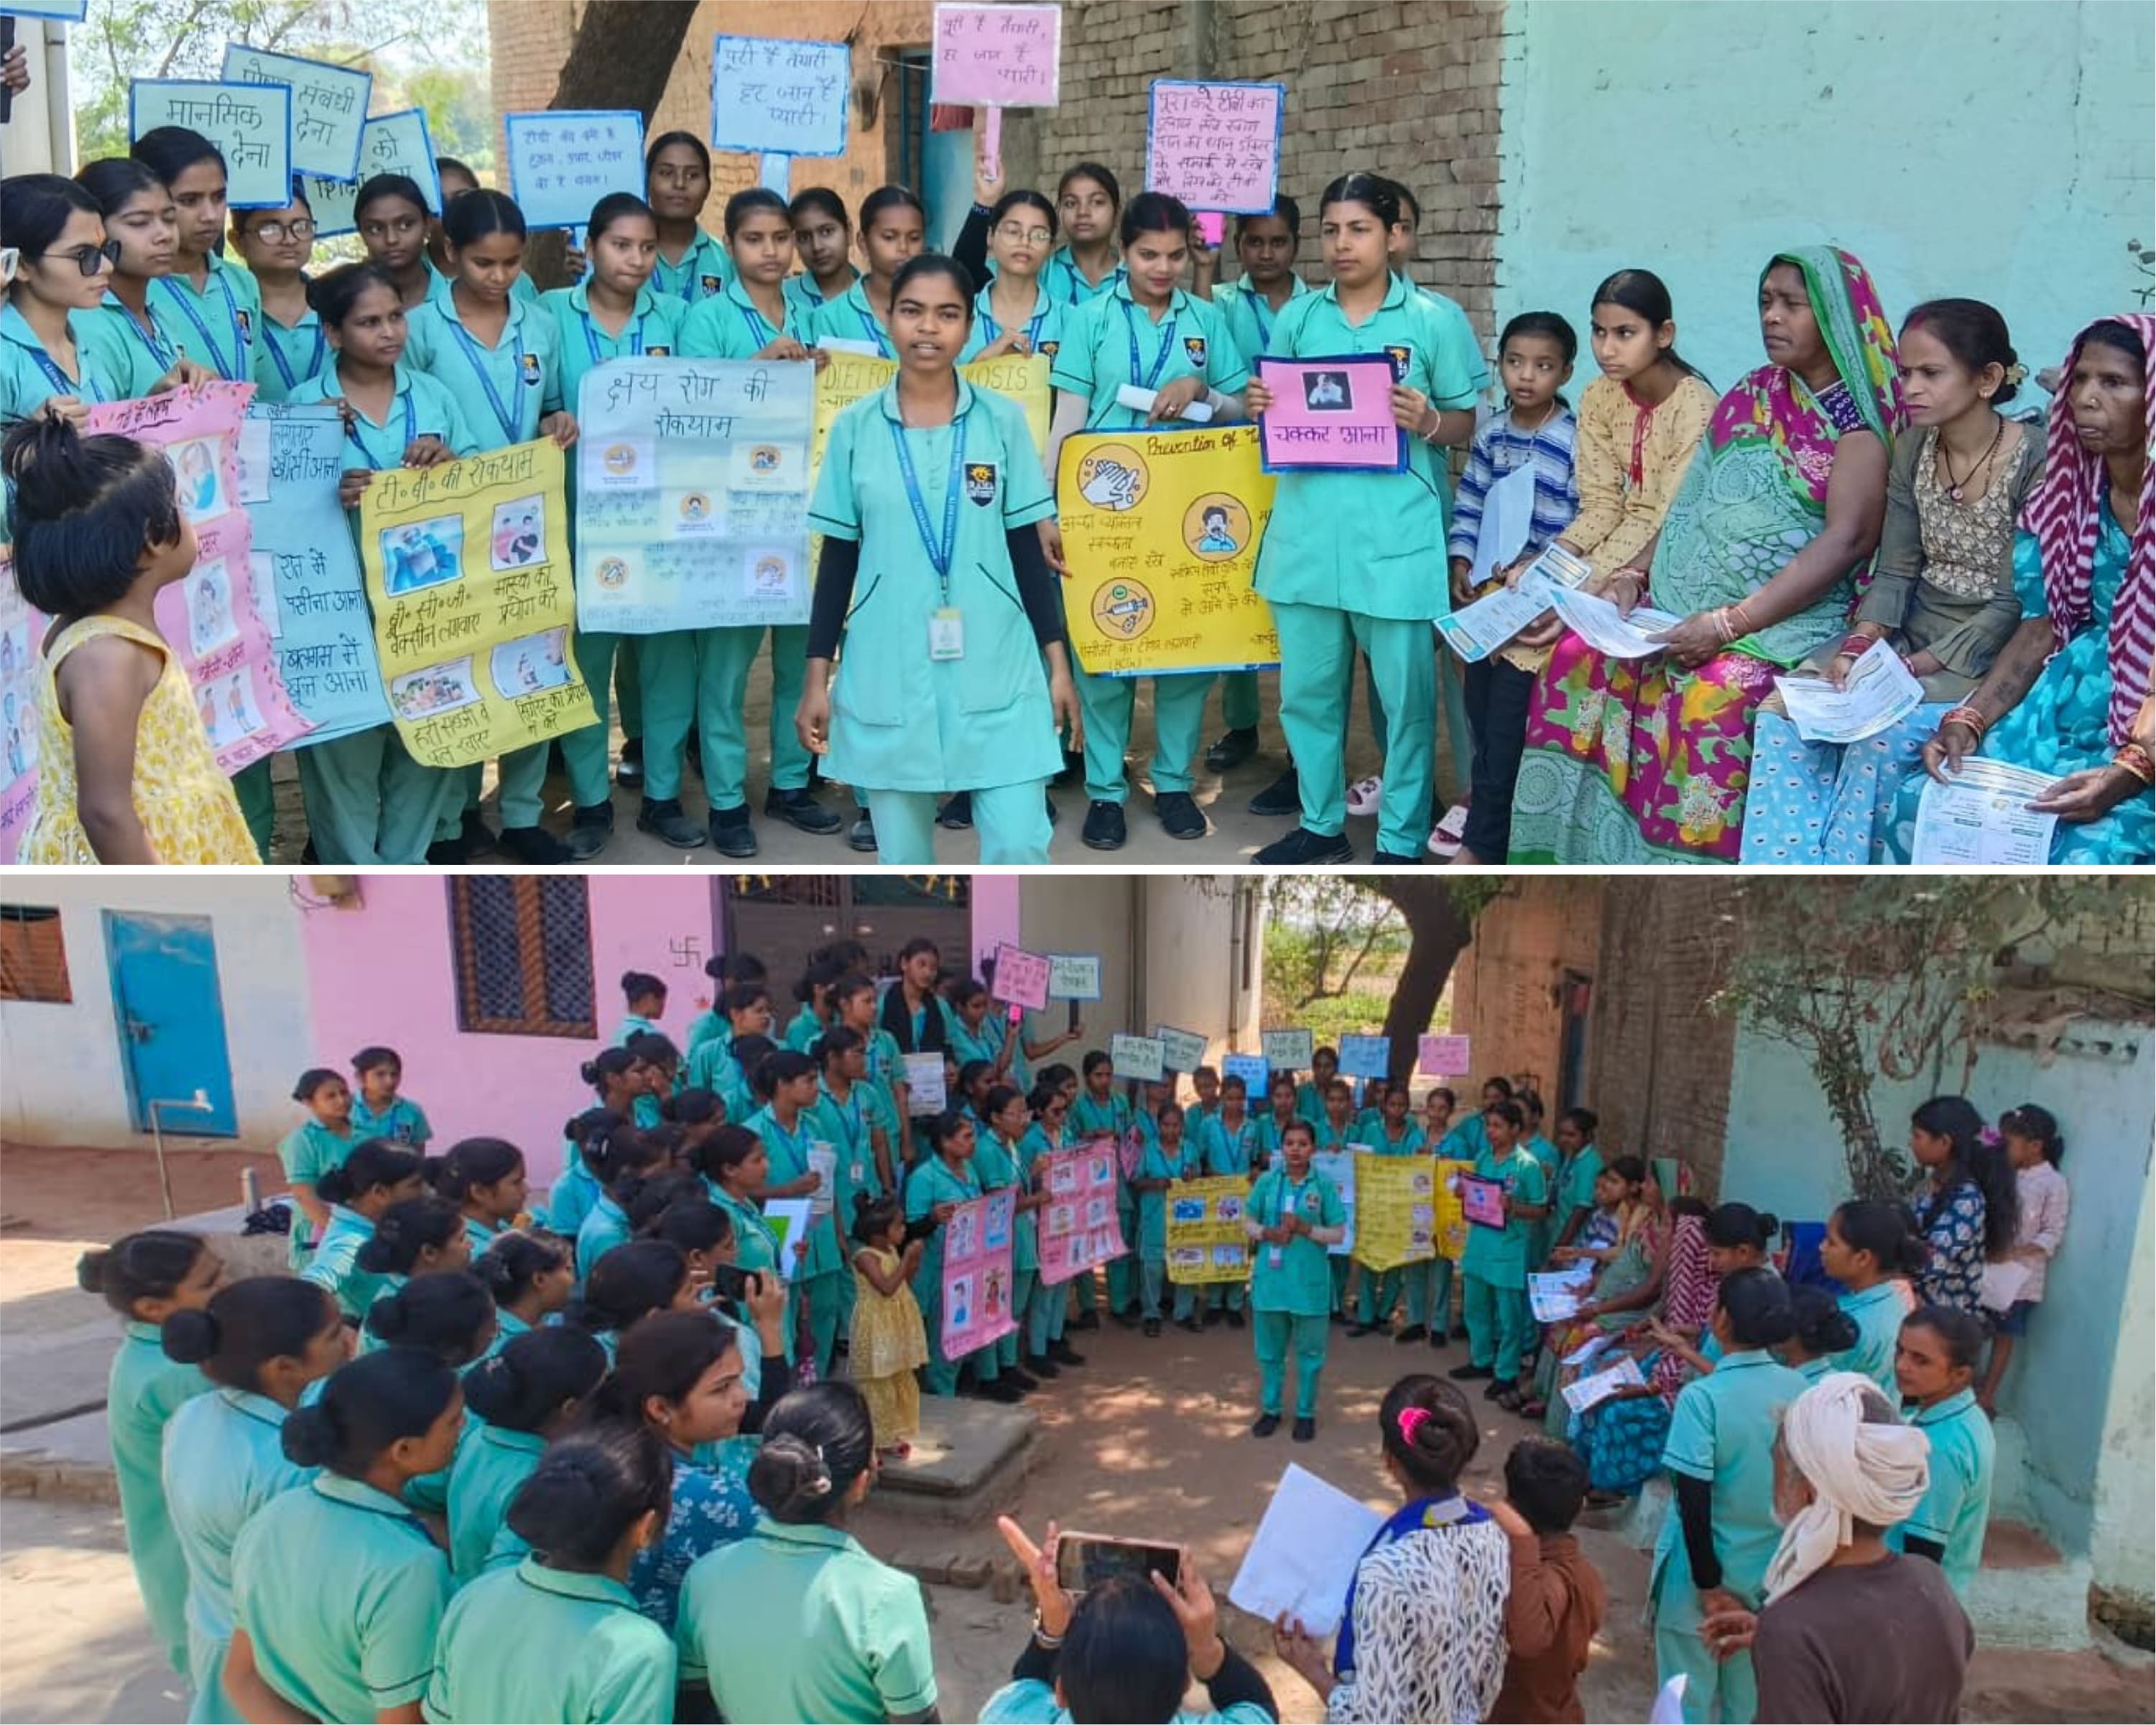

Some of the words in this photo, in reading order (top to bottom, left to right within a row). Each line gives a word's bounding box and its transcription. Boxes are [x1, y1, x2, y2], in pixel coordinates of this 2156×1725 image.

[166, 92, 264, 131] मानसिक
[295, 108, 336, 147] देना
[230, 130, 271, 170] देना
[371, 127, 398, 159] को
[678, 368, 721, 404] रोग
[744, 368, 777, 402] की
[654, 407, 744, 439] रोकथाम
[1338, 425, 1392, 444] आना
[469, 448, 534, 488] रोकथाम
[324, 670, 369, 693] आना
